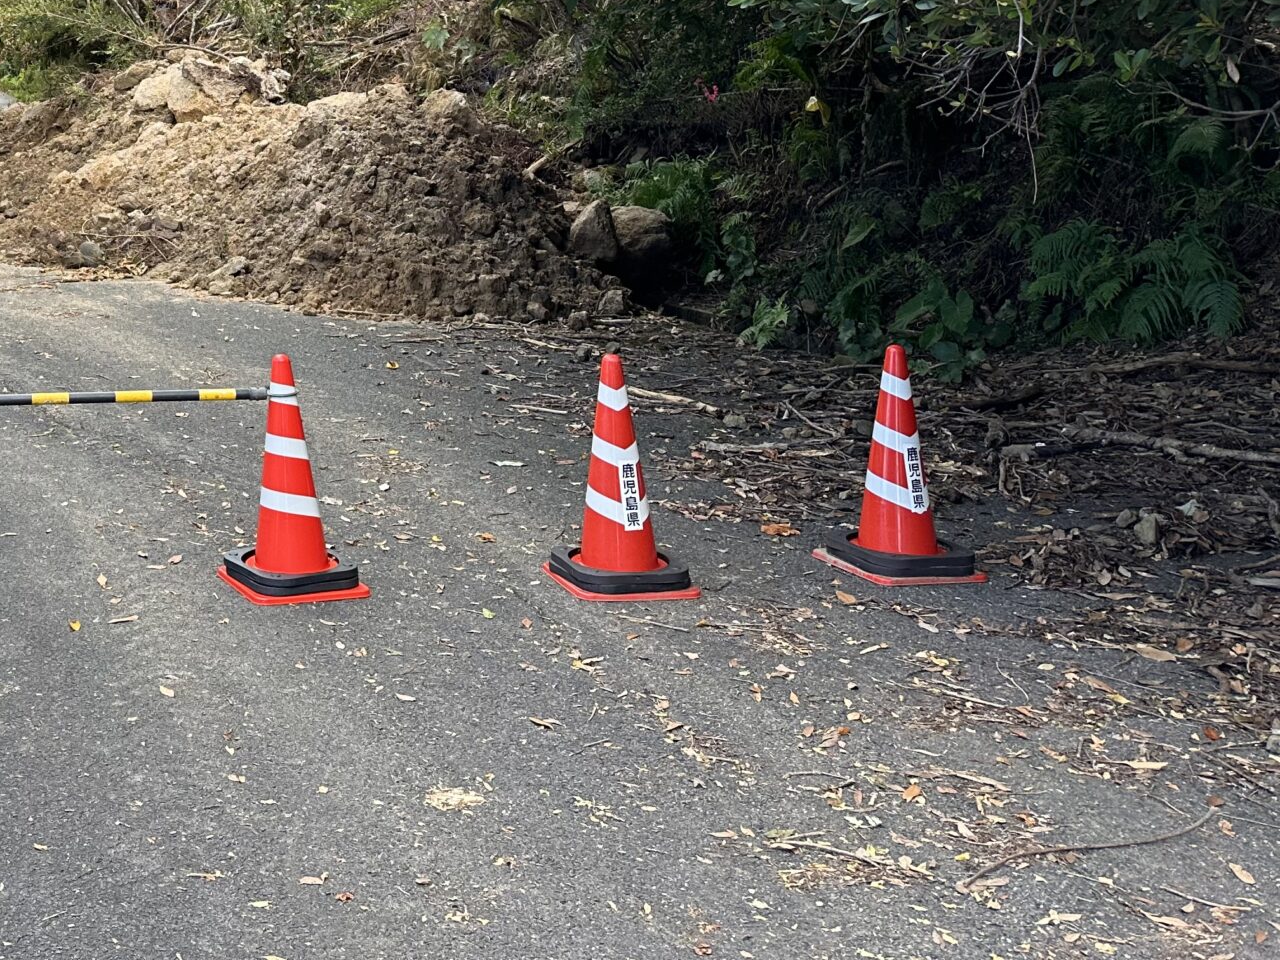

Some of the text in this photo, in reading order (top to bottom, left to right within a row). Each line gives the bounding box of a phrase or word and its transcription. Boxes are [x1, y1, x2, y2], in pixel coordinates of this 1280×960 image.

[622, 463, 640, 527] 鹿児島県
[907, 447, 925, 509] 鹿児島県
